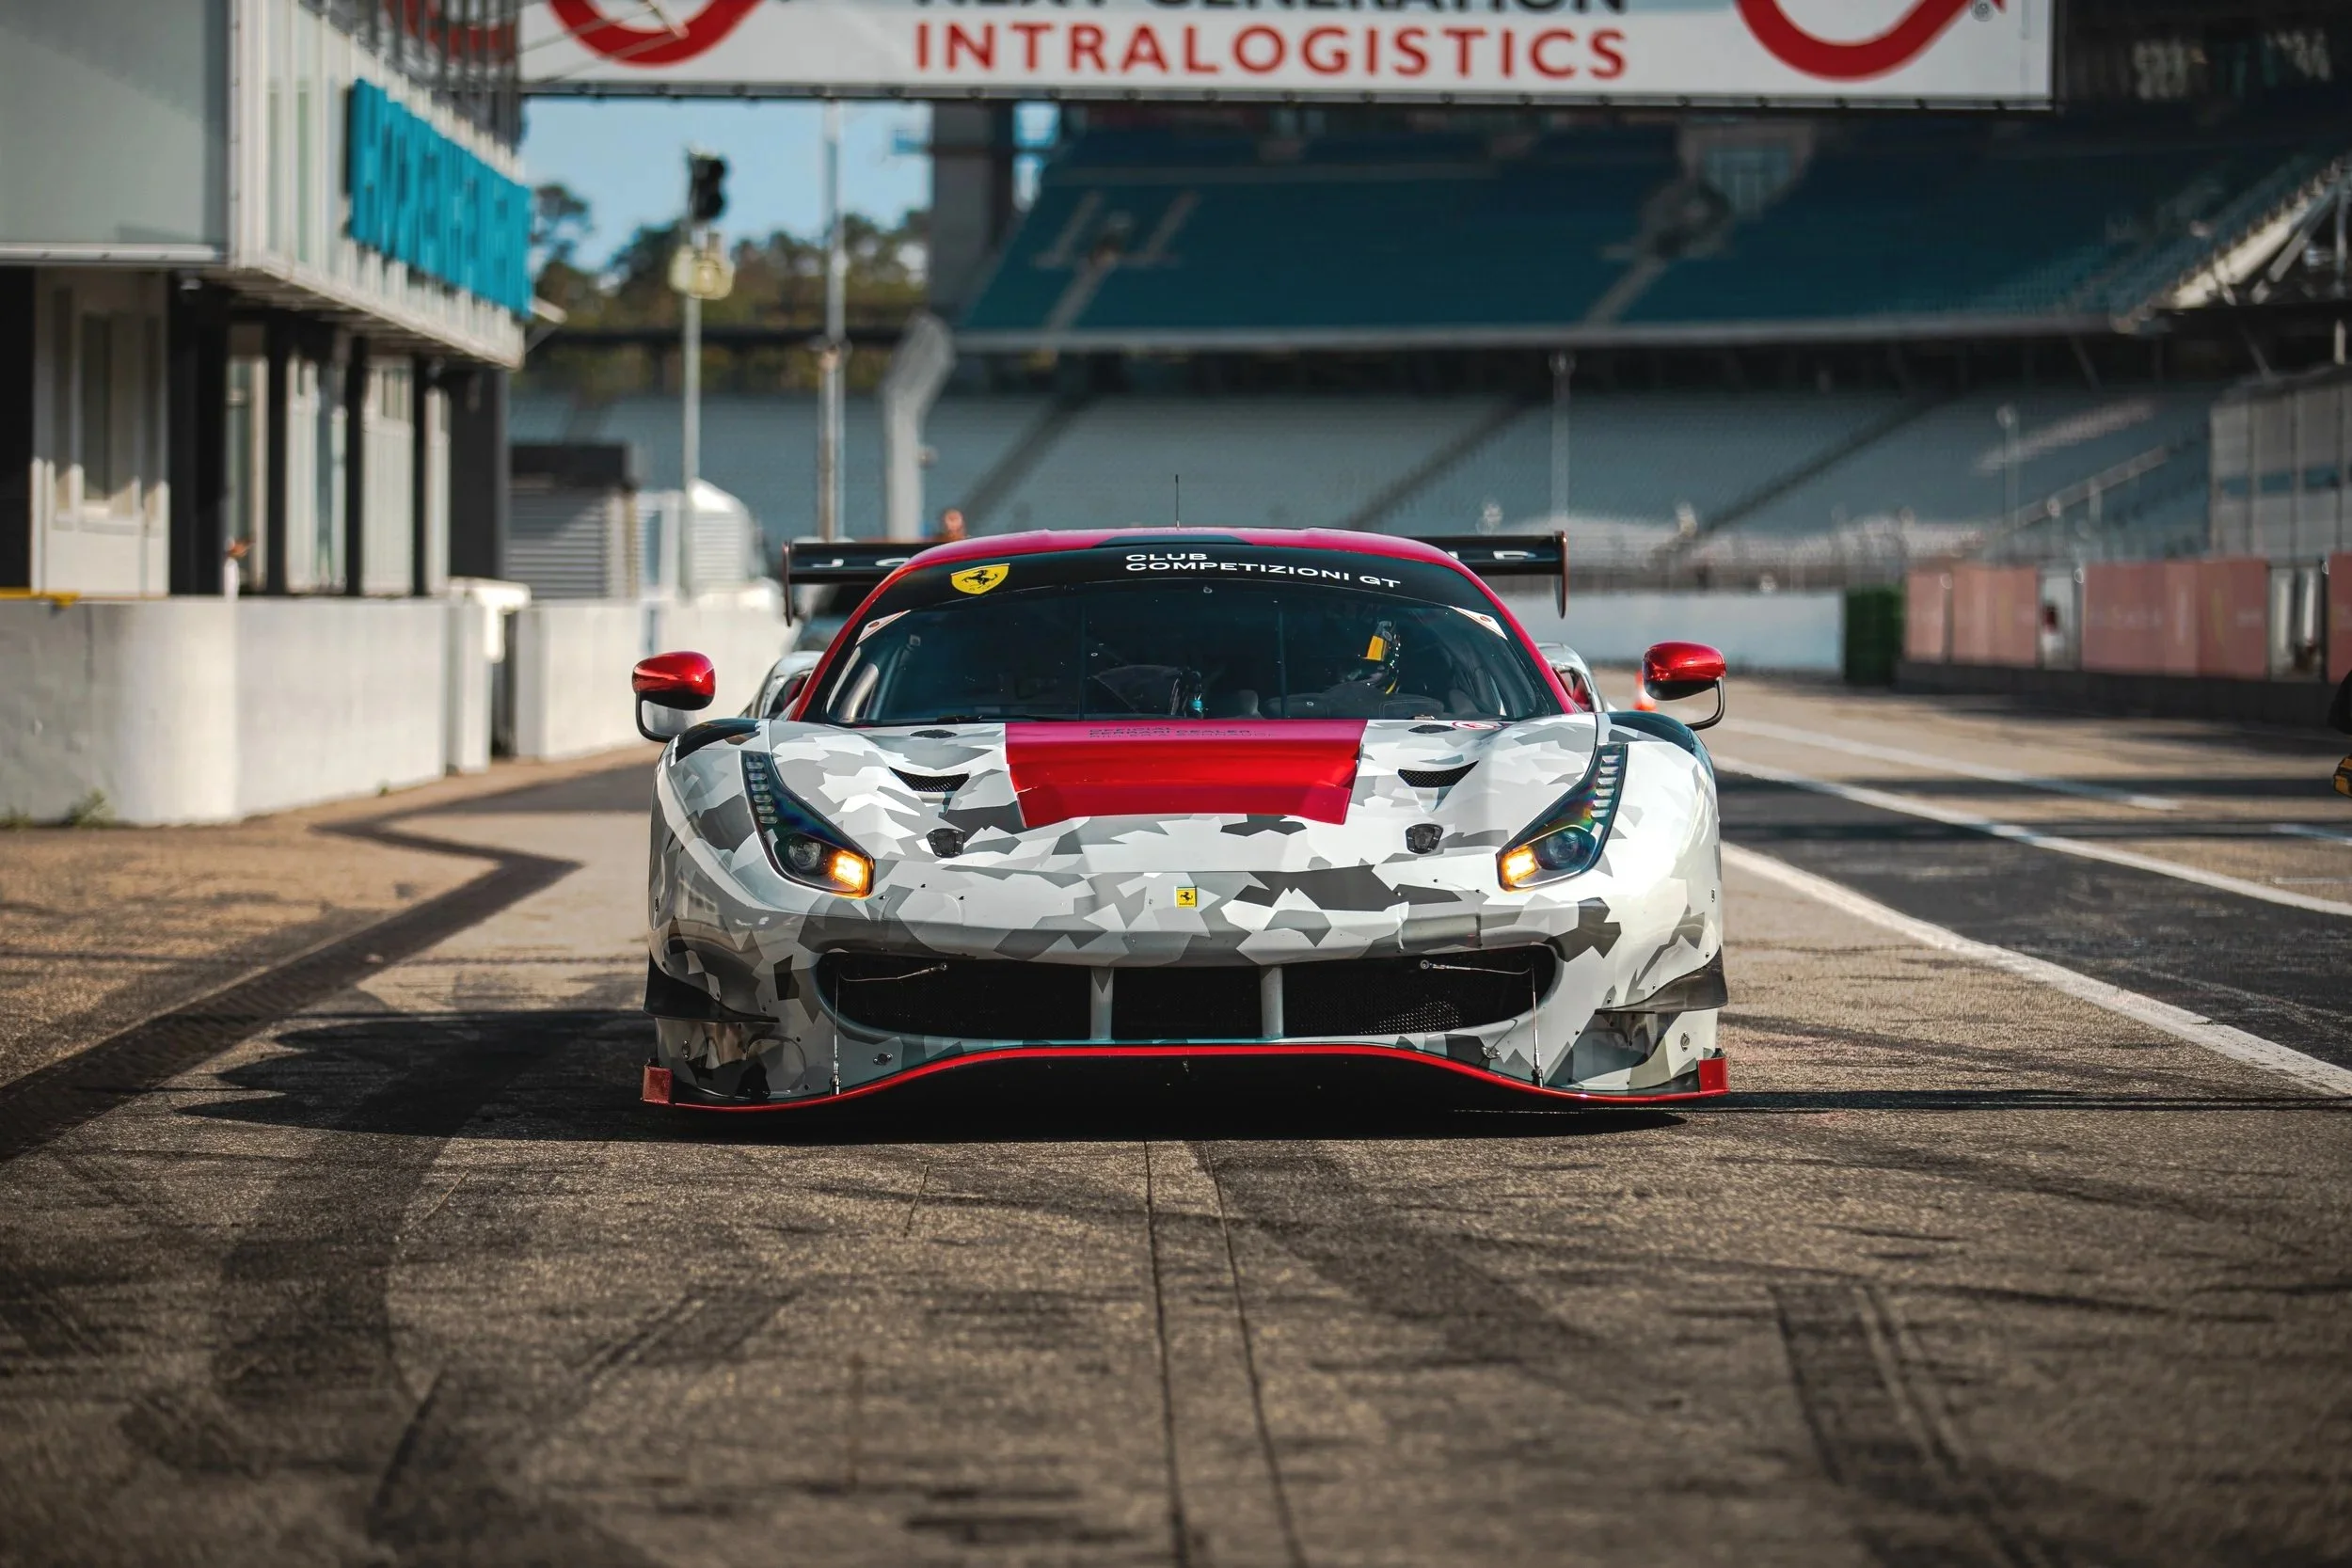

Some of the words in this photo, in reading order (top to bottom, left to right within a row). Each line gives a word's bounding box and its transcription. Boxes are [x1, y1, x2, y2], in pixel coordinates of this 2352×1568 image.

[916, 22, 1627, 80] INTRALOGISTICS
[1125, 553, 1207, 562] CLUB
[1125, 562, 1350, 581] COMPETIZIONI
[1359, 575, 1401, 589] GT
